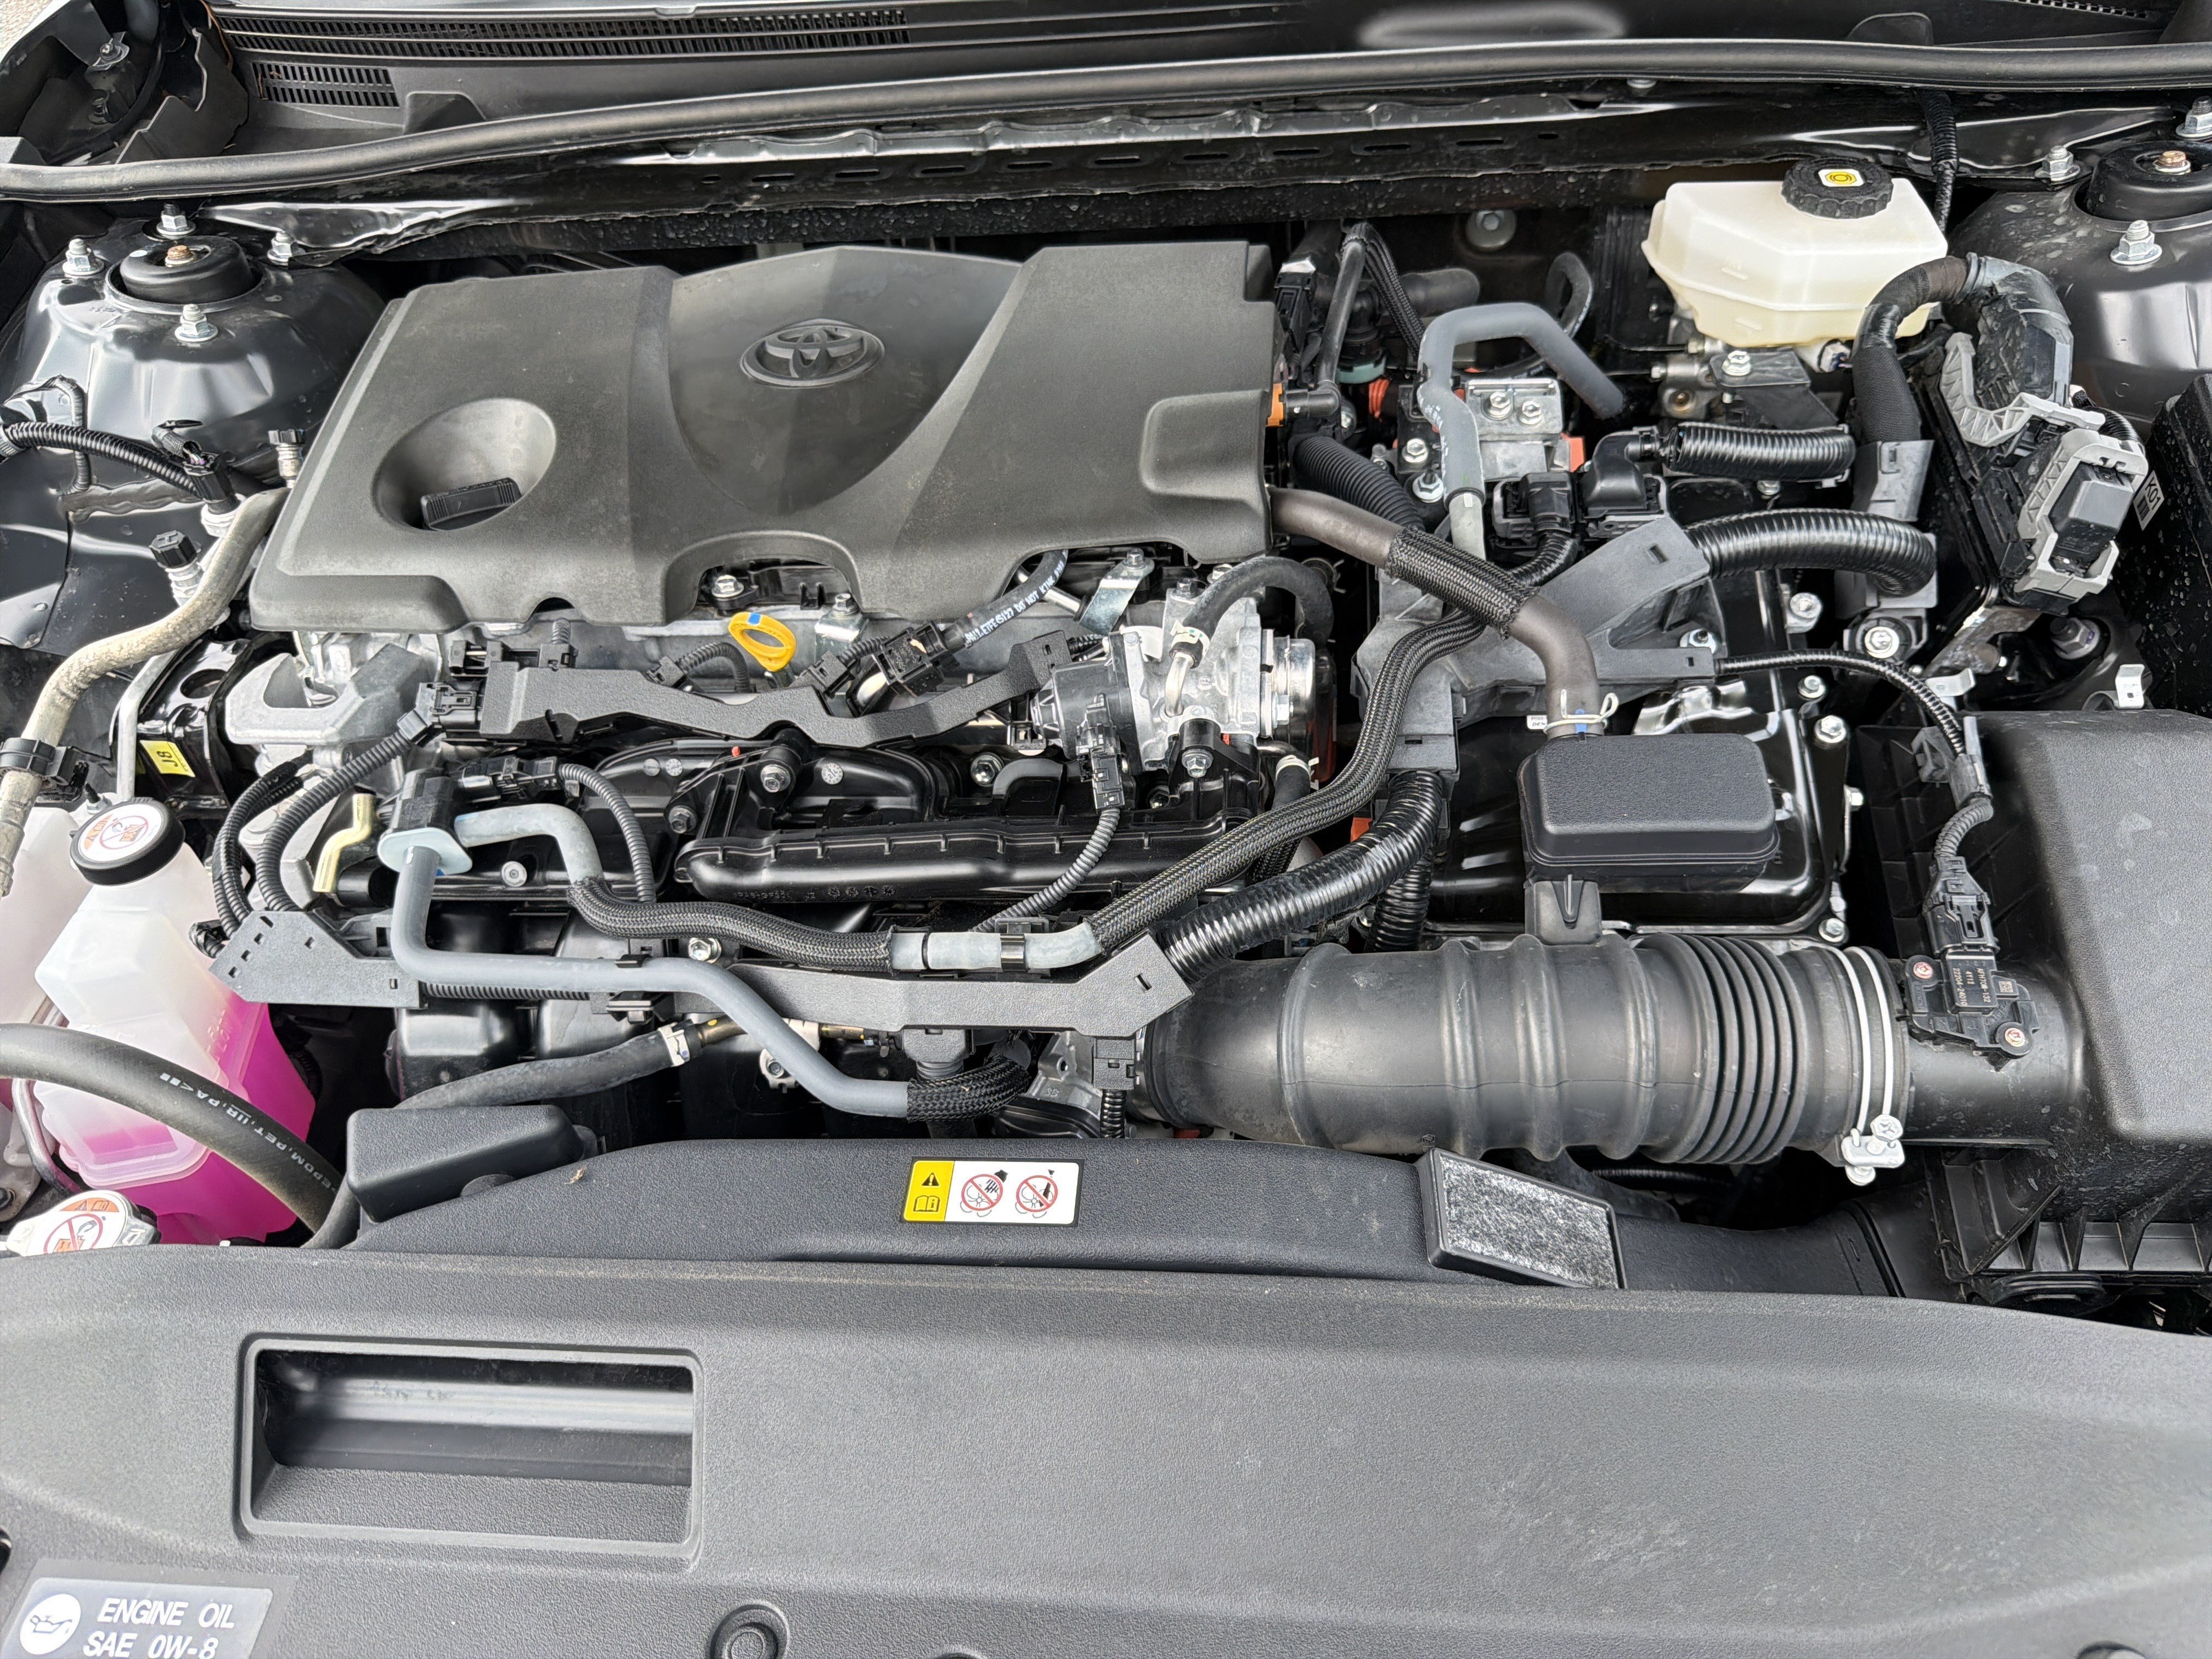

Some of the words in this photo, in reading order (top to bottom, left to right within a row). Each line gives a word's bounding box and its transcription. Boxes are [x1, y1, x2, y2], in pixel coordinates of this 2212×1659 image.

[2145, 476, 2161, 510] K01
[156, 751, 179, 768] J8
[1953, 967, 1968, 1006] 22204-24010
[98, 1598, 189, 1626] ENGINE
[199, 1602, 235, 1629] OIL
[83, 1630, 137, 1657] SAE
[148, 1635, 218, 1659] 0W-8
